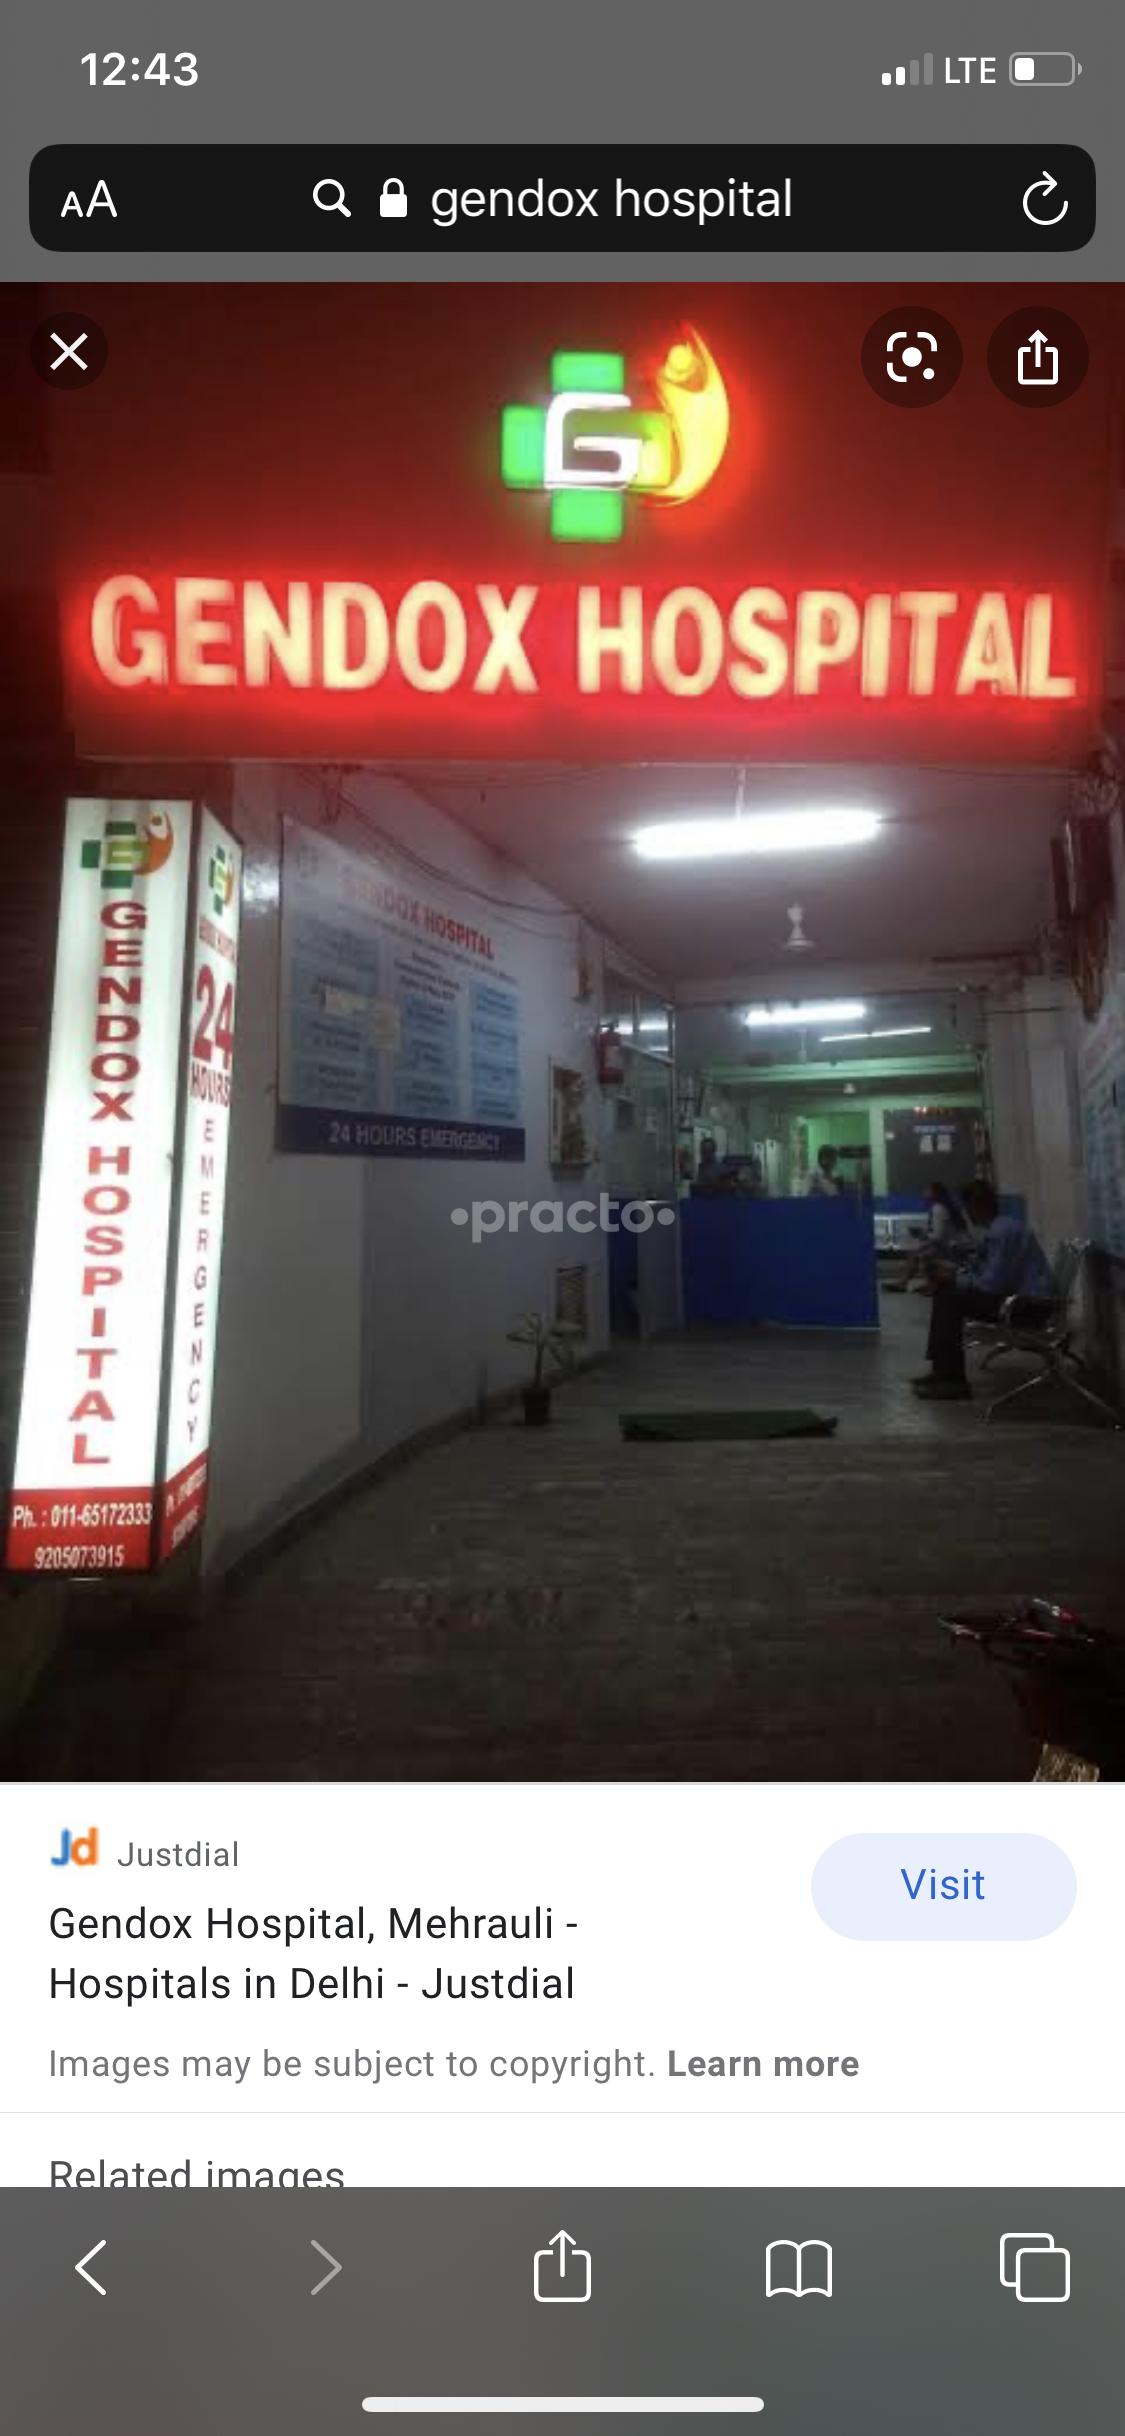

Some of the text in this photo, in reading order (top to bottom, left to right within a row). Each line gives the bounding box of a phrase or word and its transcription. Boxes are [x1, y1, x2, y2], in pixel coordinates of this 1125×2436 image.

[81, 52, 198, 86] 12:43
[945, 57, 997, 84] LTE
[431, 178, 792, 227] gendox hospital
[90, 575, 1077, 700] GENDOX HOSPITAL
[342, 868, 420, 927] ENDOX
[422, 902, 495, 960] HOSPITAL
[193, 963, 234, 1070] 24
[191, 1060, 231, 1107] HOURS
[329, 1121, 500, 1152] 24 HOURS EMERGENCY
[69, 902, 147, 1465] GENDOX HOSPITAL
[186, 1118, 215, 1443] EMERGENCY
[34, 1544, 125, 1570] 9205073915
[118, 1840, 238, 1868] Justdial
[900, 1868, 985, 1901] Visit
[49, 1906, 193, 1940] Gendox
[208, 1905, 374, 1947] Hospital,
[389, 1905, 552, 1940] Mehrauli
[50, 1966, 231, 2007] Hospitals
[245, 1967, 276, 1999] in
[291, 1966, 383, 2000] Delhi
[421, 1966, 573, 2000] Justdial
[50, 2048, 860, 2085] Images may be subject to copyright. Learn more
[50, 2159, 191, 2188] Related
